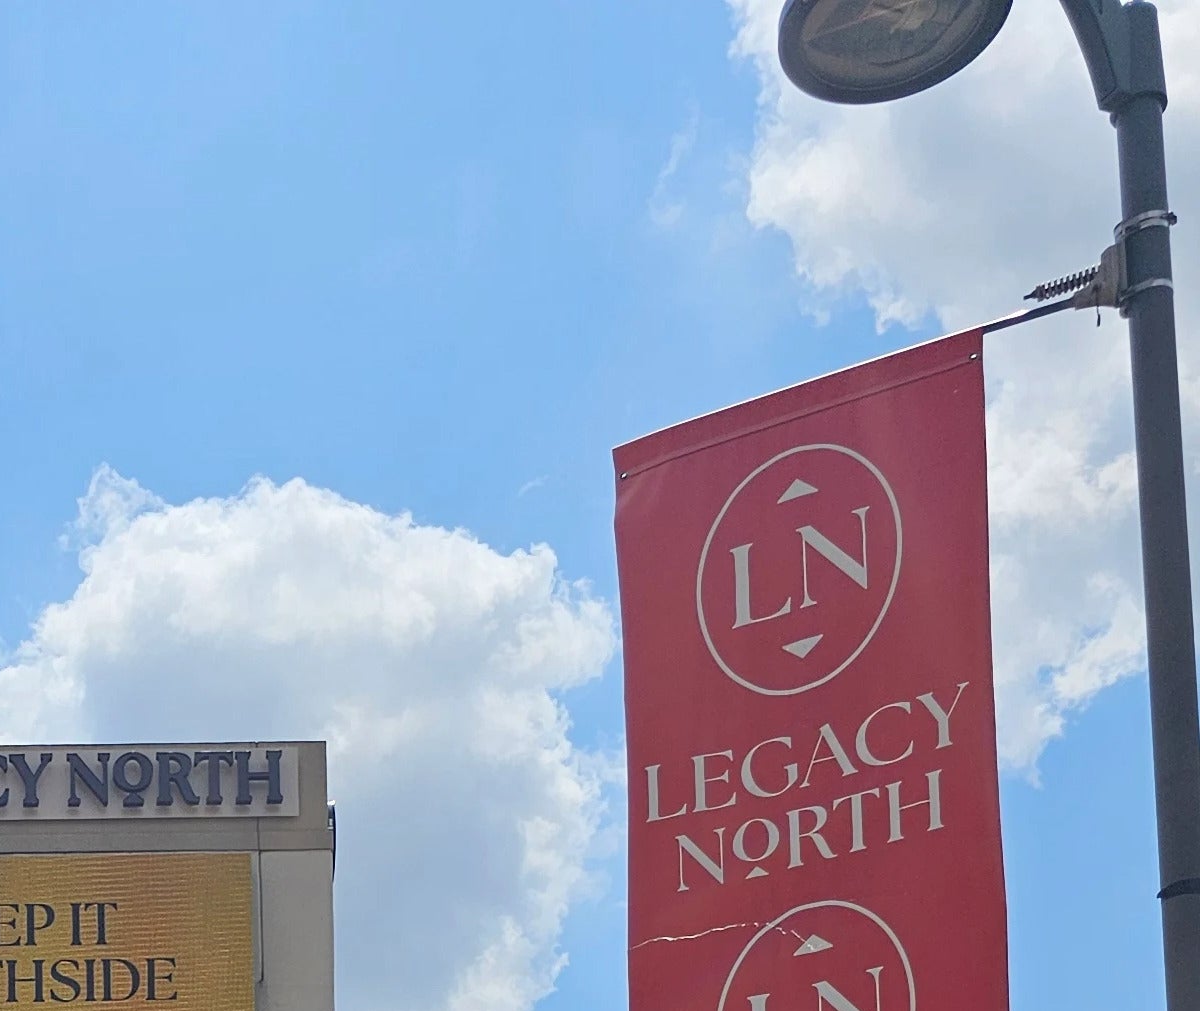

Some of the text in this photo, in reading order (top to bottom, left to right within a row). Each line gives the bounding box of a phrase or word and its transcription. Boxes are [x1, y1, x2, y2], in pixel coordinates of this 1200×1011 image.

[729, 505, 871, 631] LN
[66, 749, 284, 809] NORTH
[644, 681, 970, 825] LEGACY
[675, 769, 946, 894] NORTH
[69, 902, 118, 946] IT
